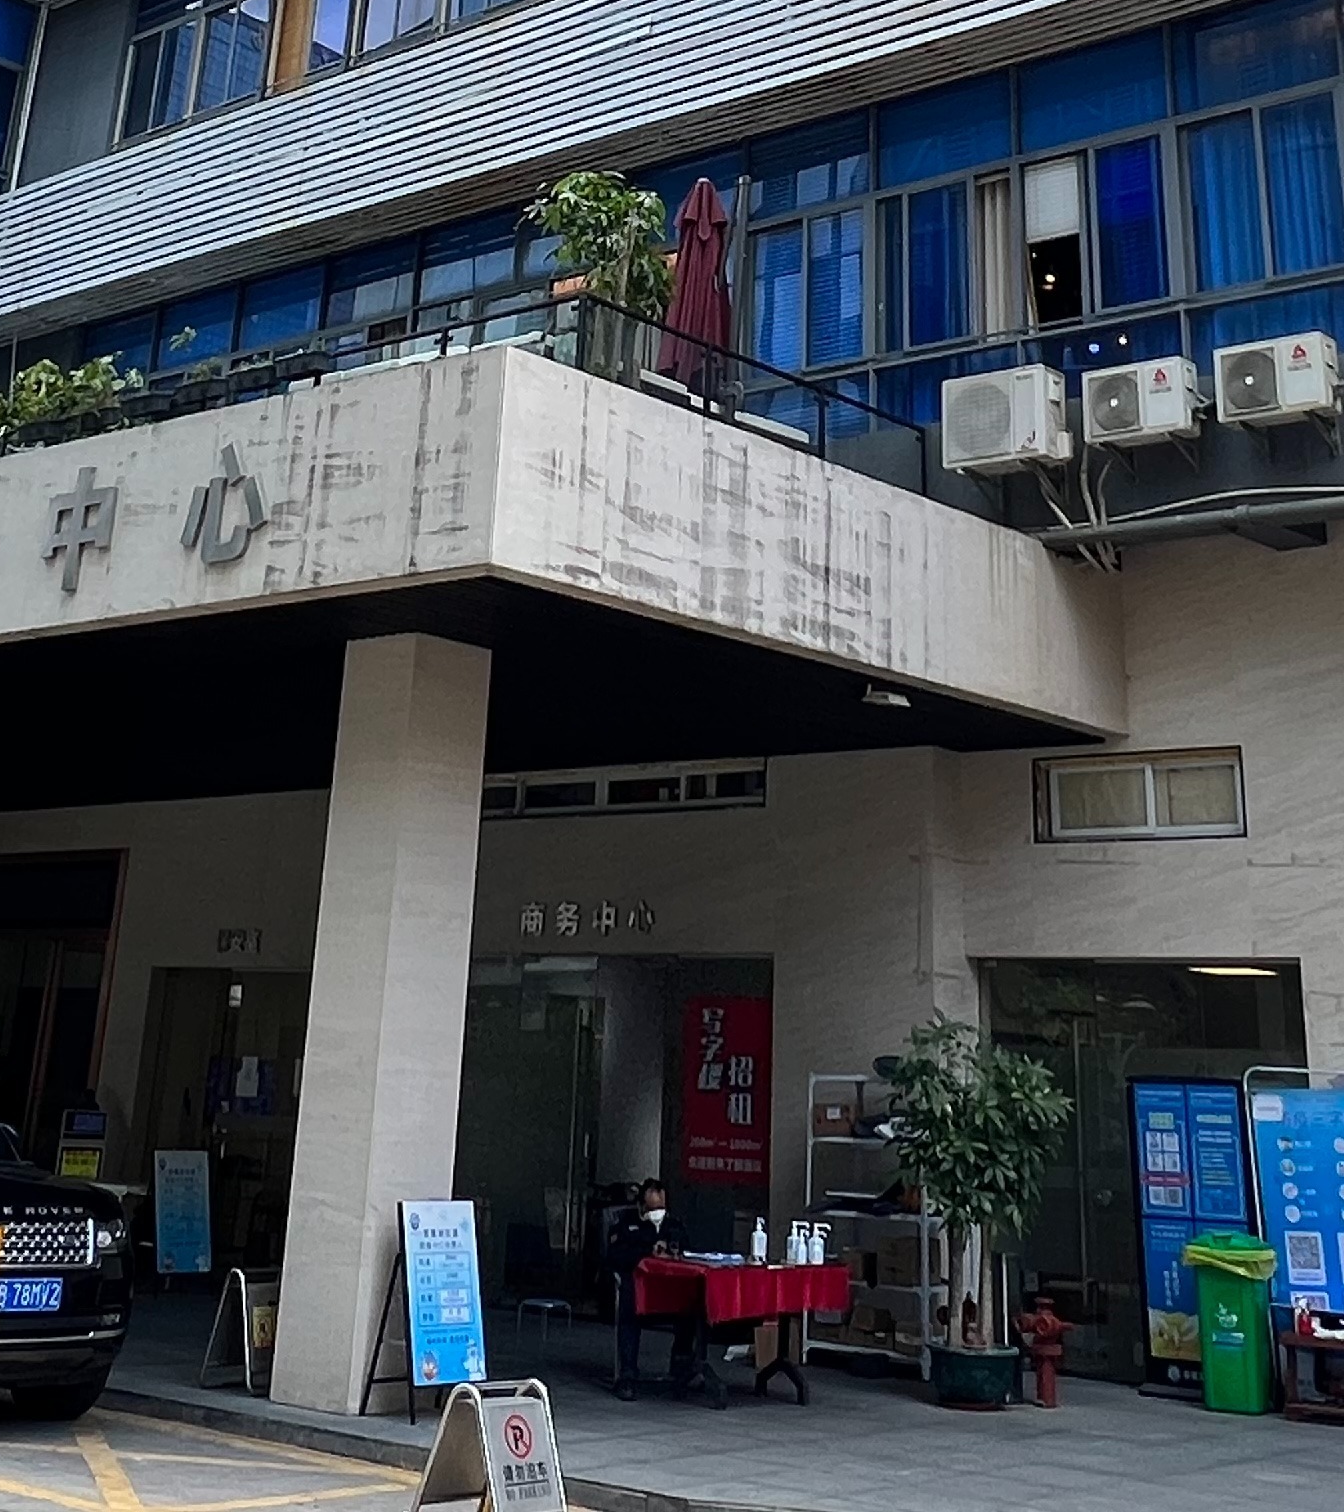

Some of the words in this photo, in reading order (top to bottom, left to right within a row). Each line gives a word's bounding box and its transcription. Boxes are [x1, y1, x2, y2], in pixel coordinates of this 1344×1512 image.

[520, 899, 655, 937] 商务中心
[728, 1055, 754, 1125] 招租
[24, 1206, 84, 1215] ROVER
